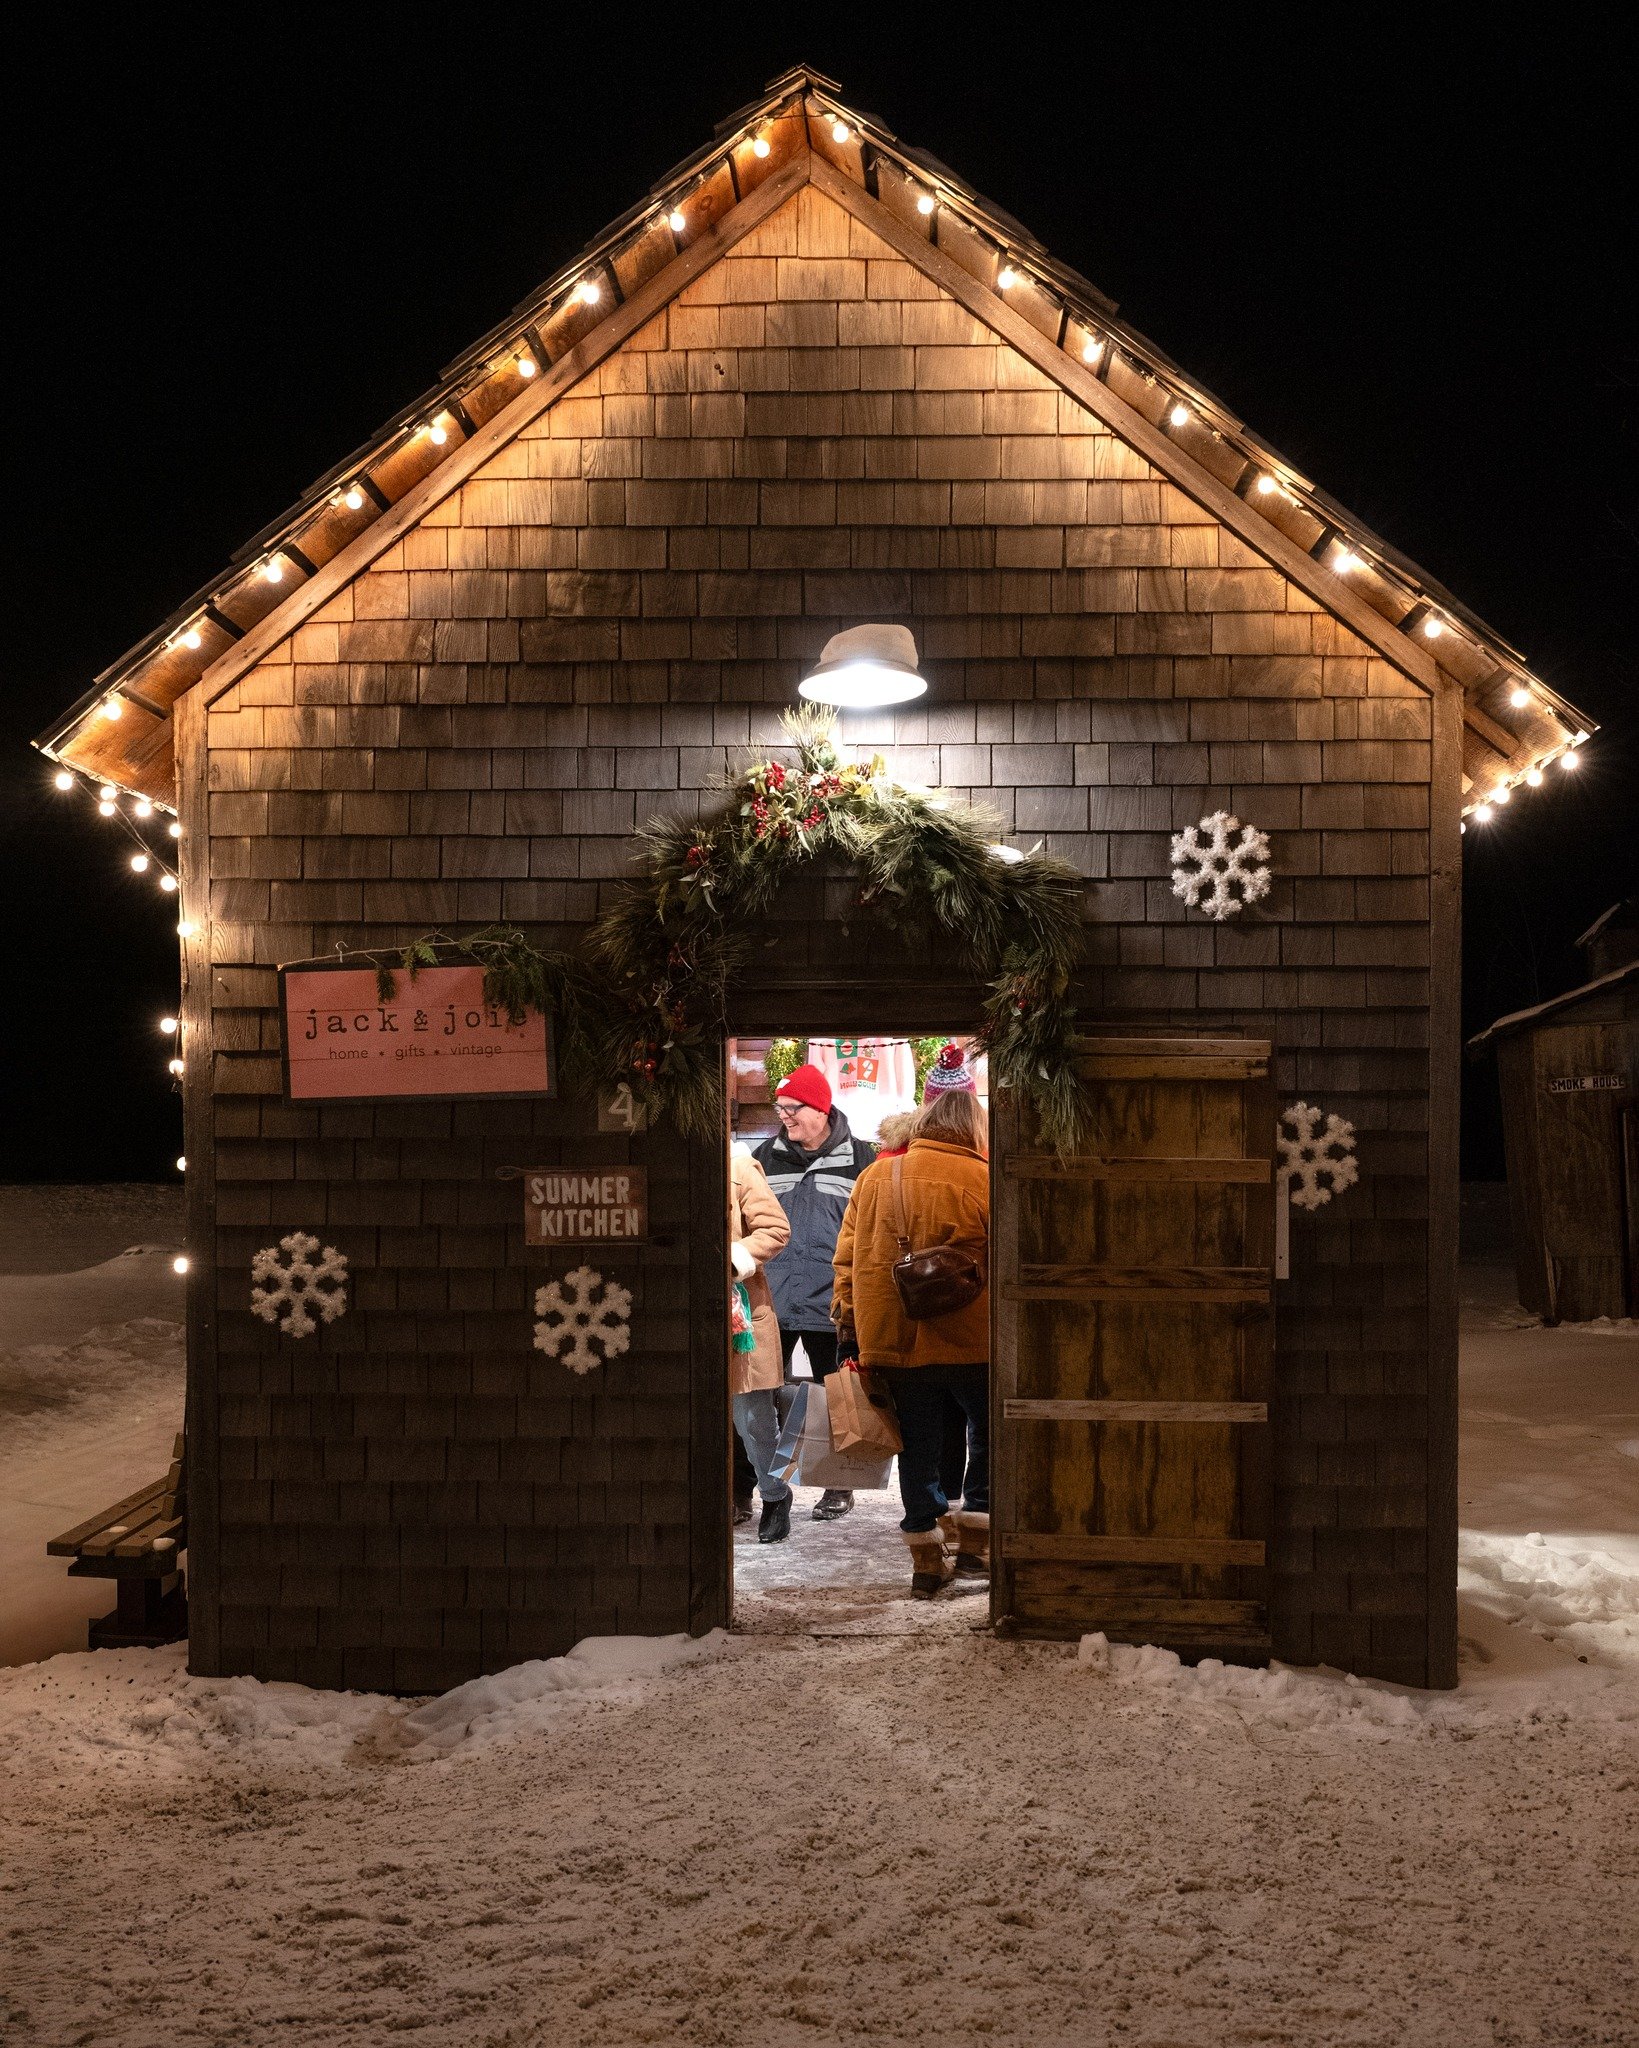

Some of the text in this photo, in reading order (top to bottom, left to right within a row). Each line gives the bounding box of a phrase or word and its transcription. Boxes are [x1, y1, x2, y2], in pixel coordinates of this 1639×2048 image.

[305, 1007, 399, 1040] jack
[413, 1009, 429, 1032] &
[329, 1043, 502, 1061] home gifts vintage
[839, 1080, 857, 1089] HOLLY
[1551, 1076, 1625, 1091] SMOKE HOUSE
[608, 1087, 637, 1127] 4
[530, 1176, 631, 1205] SUMMER
[540, 1208, 640, 1237] KITCHEN
